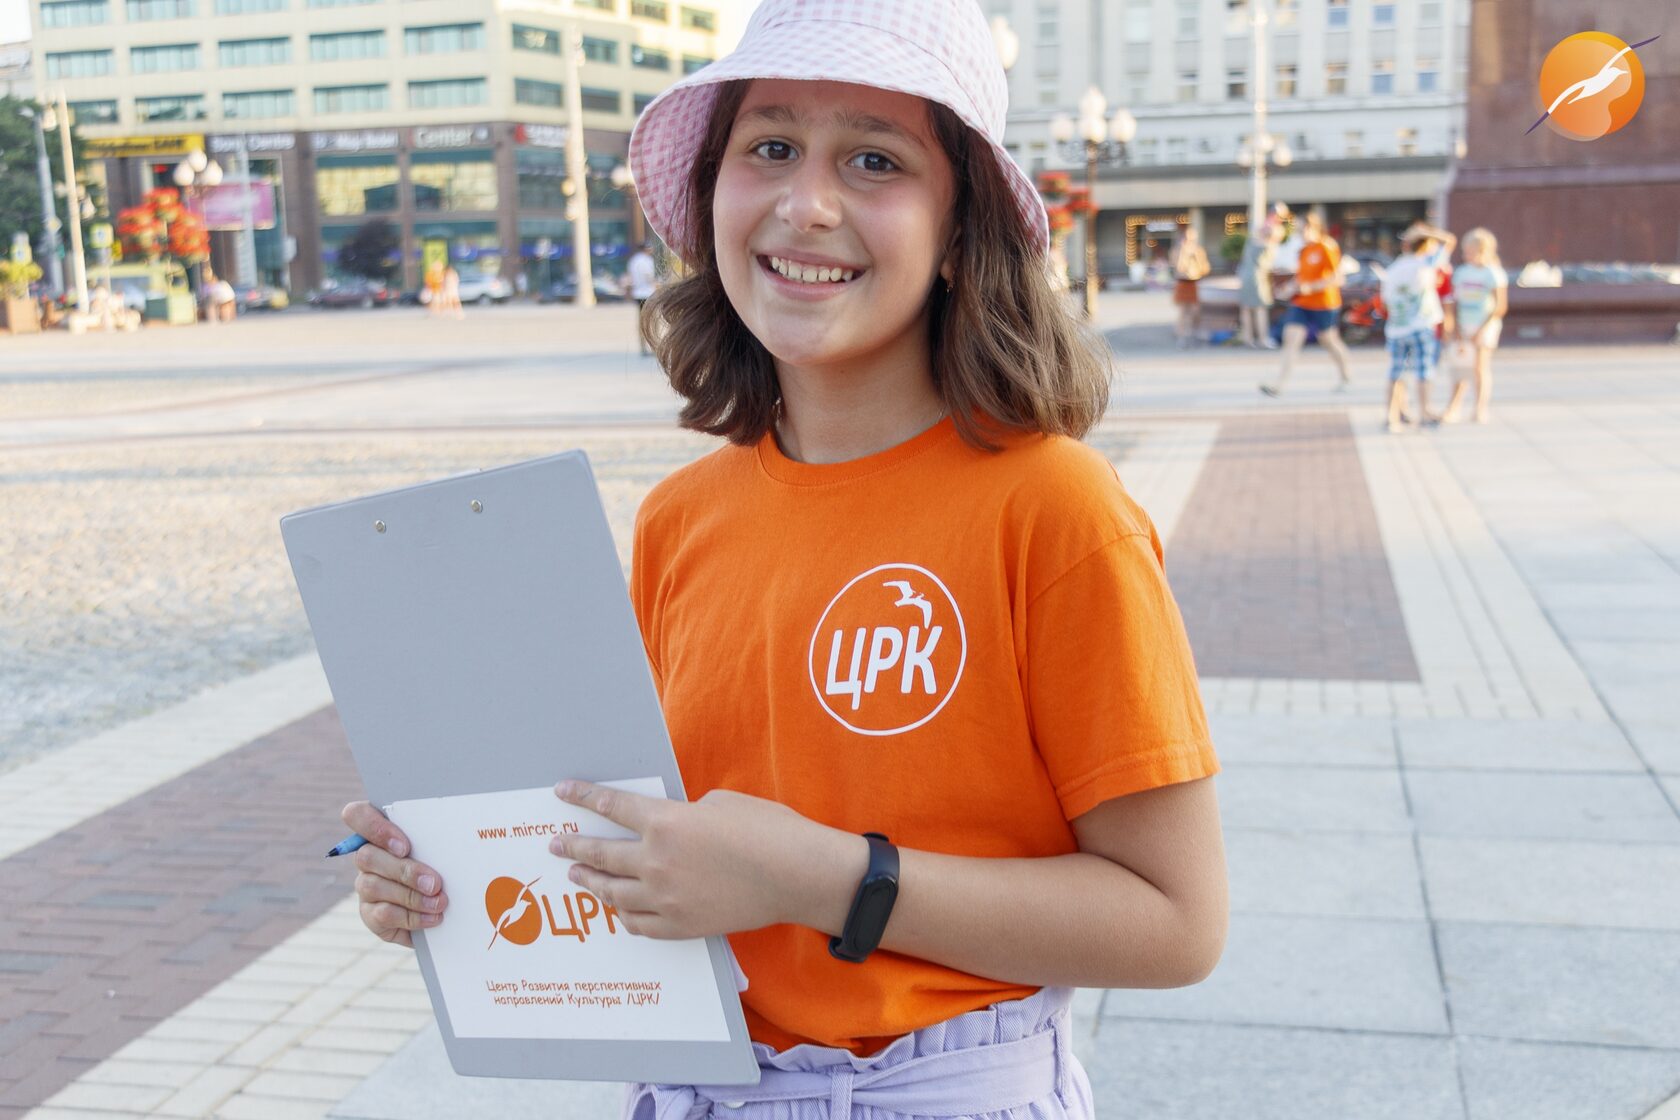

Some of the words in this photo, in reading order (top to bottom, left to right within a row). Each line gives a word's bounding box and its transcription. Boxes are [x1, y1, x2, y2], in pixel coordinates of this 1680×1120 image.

[826, 625, 943, 711] ЦРК
[477, 821, 579, 840] www.mircrc.ru
[486, 979, 518, 994] Центр
[521, 978, 570, 992] Развития
[574, 980, 662, 994] перспективных
[494, 992, 563, 1008] направлений
[567, 992, 621, 1009] Культуры
[626, 991, 660, 1007] /ЦРК/
